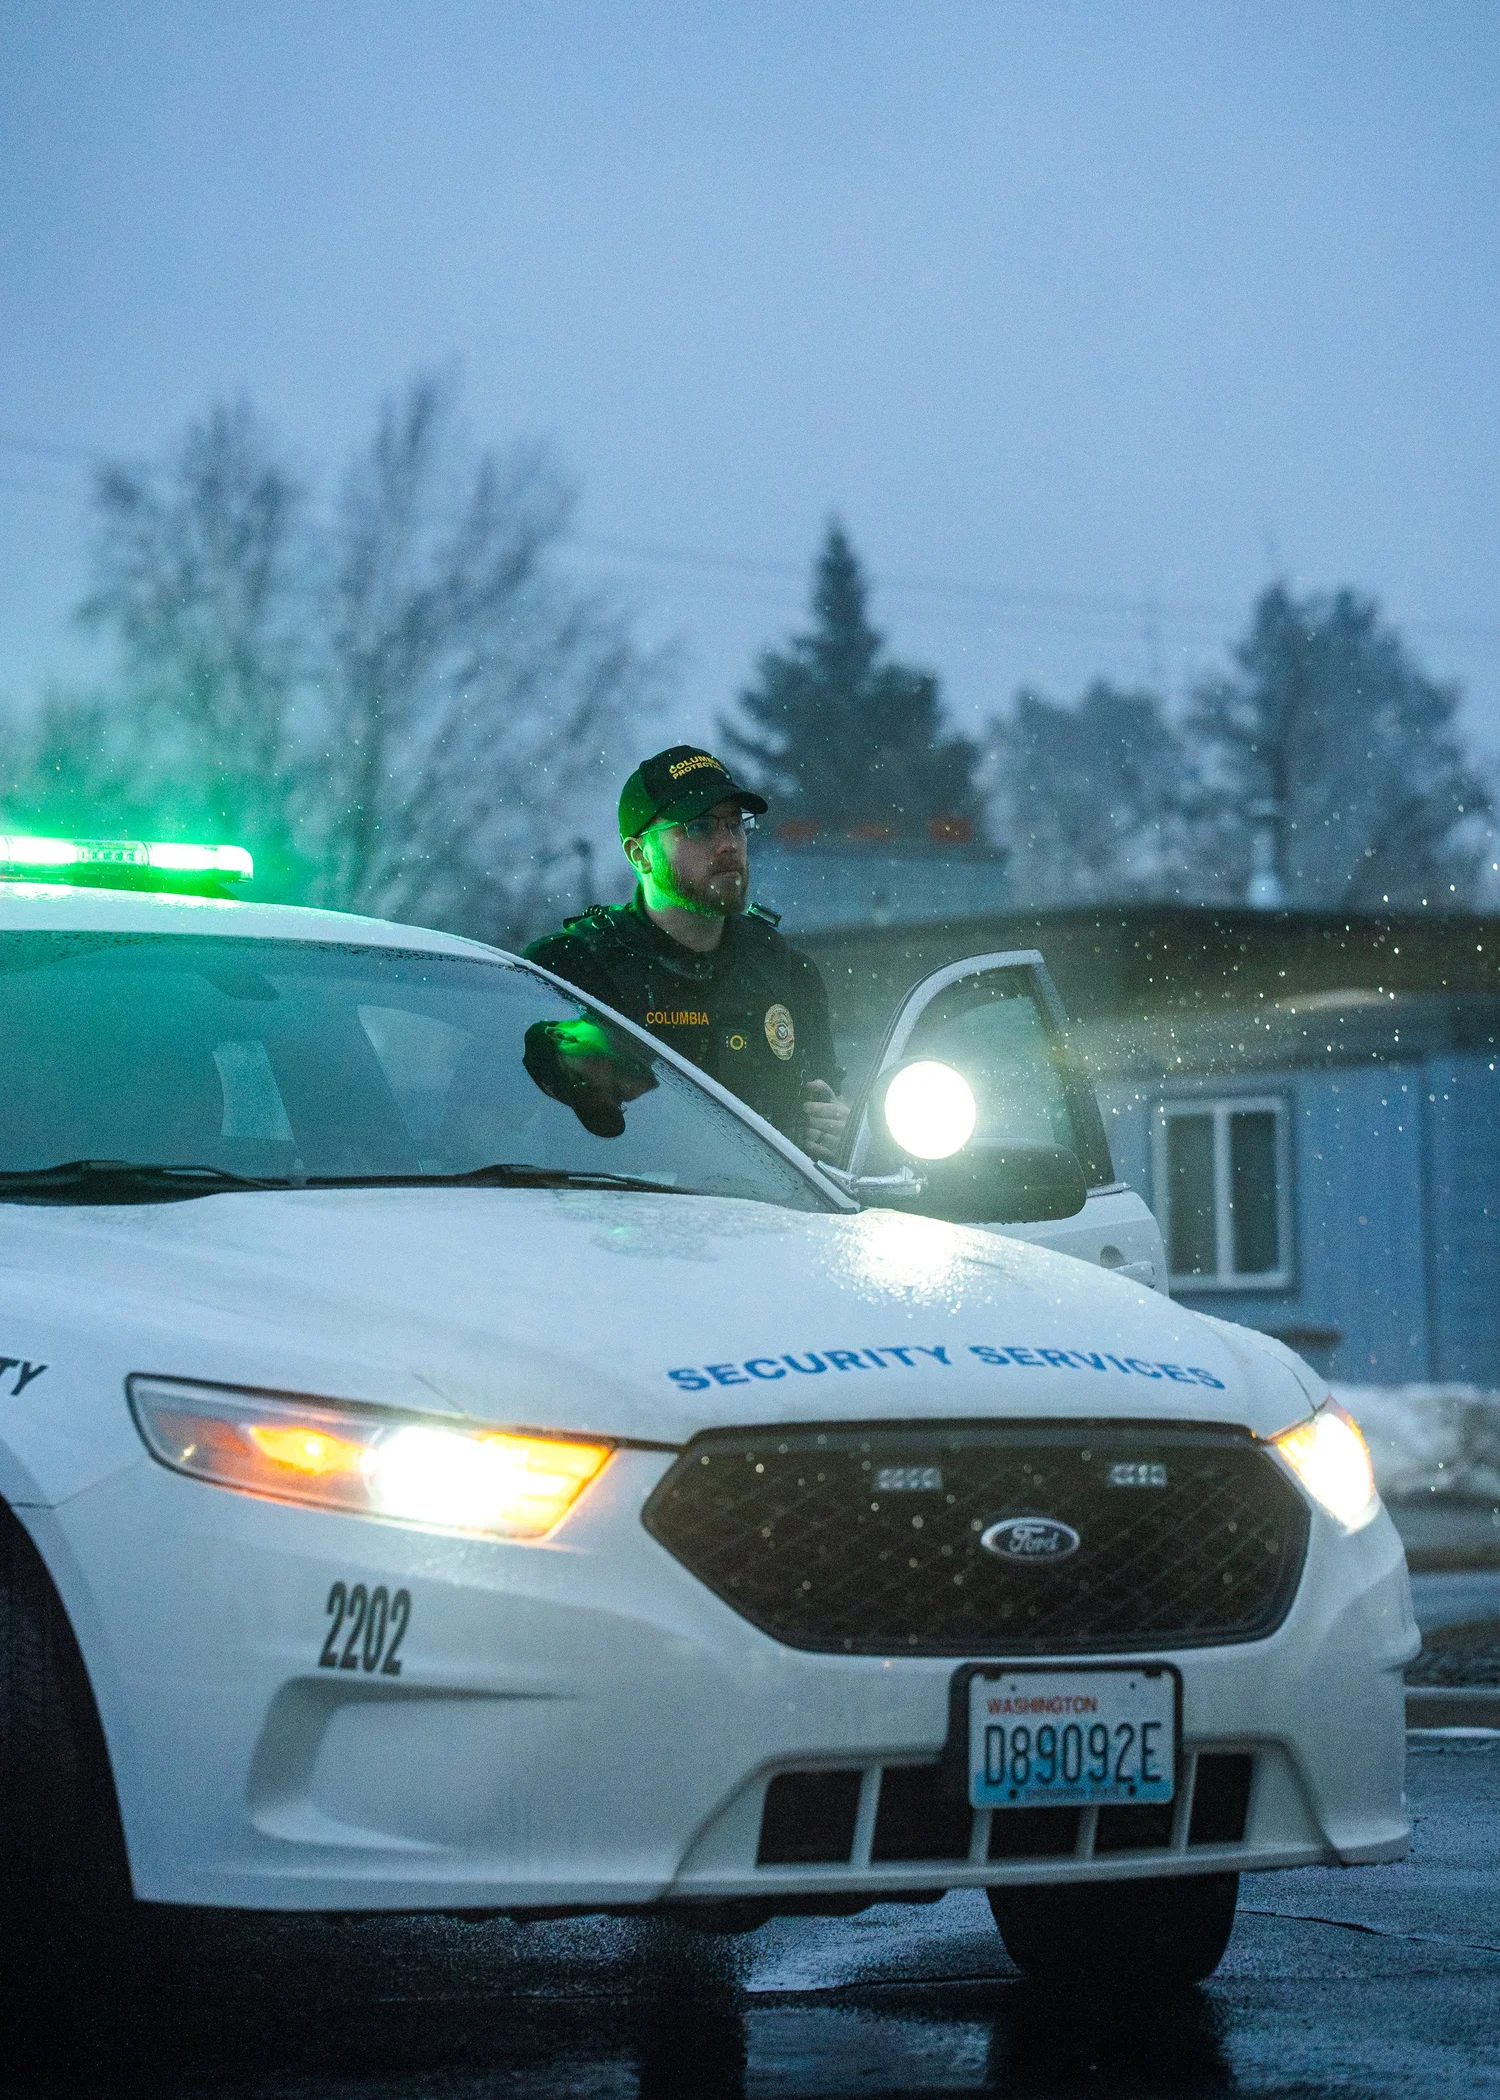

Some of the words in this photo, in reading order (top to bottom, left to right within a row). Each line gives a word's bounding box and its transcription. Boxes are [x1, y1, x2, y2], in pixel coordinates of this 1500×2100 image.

[645, 1011, 710, 1025] COLUMBIA
[667, 1346, 952, 1391] SECURITY
[968, 1345, 1226, 1390] SERVICES
[1009, 1526, 1060, 1553] Ford
[318, 1581, 412, 1676] 2202
[986, 1696, 1098, 1714] WASHINGTON
[984, 1721, 1162, 1785] D89092E
